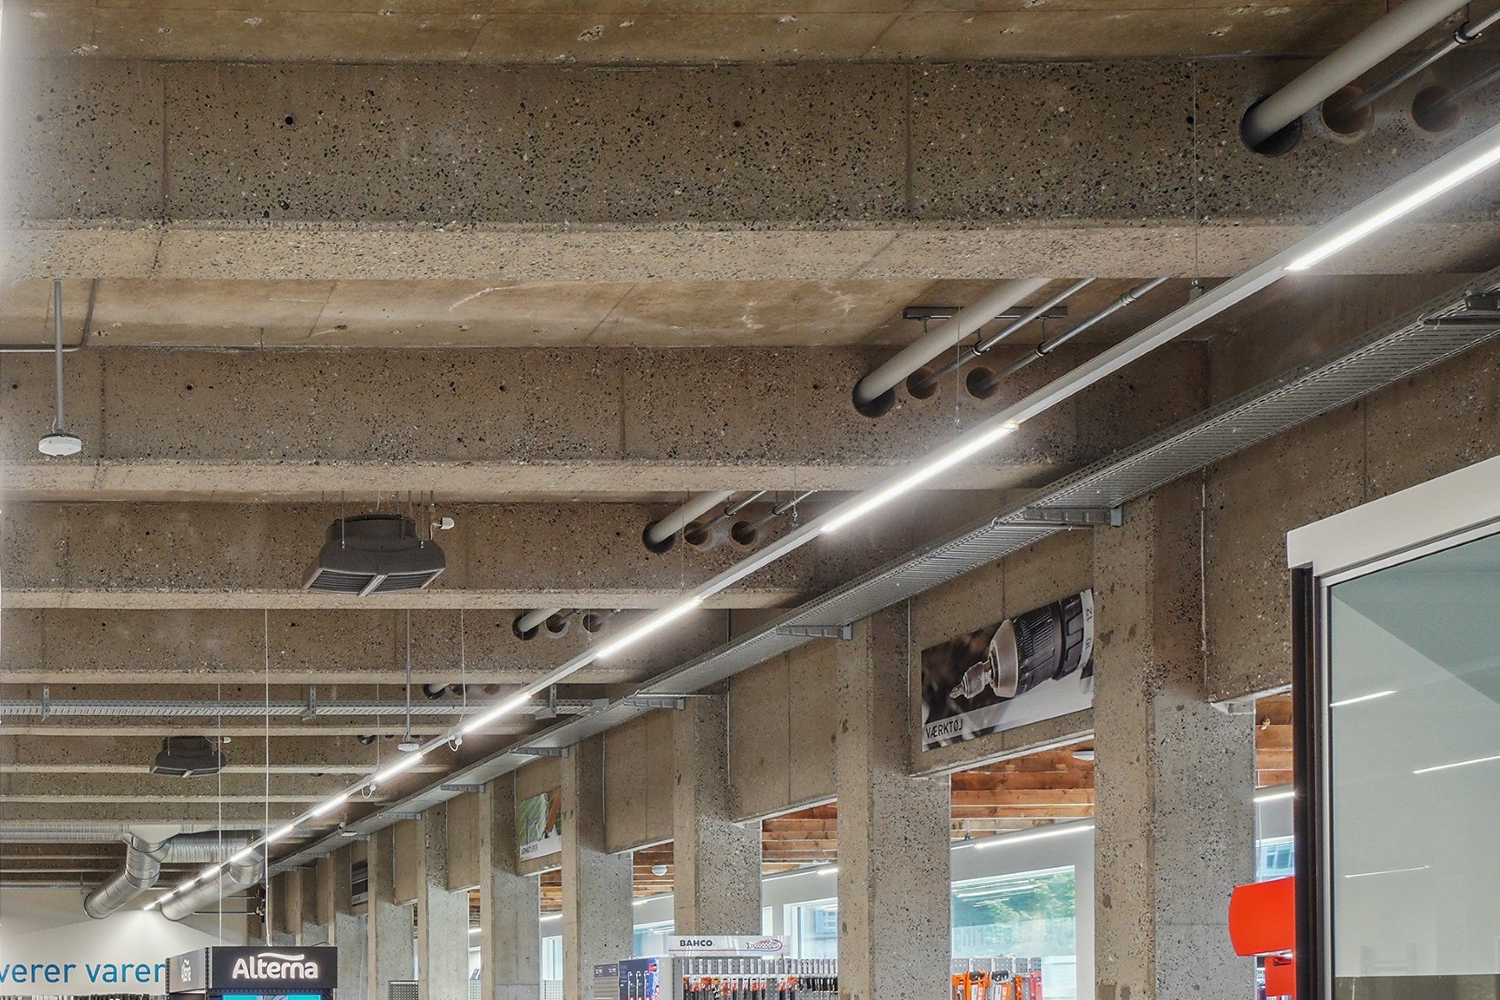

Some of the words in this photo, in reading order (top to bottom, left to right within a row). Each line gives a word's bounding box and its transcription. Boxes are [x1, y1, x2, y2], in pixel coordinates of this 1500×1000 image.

[925, 718, 964, 740] VÆRKTØJ
[680, 939, 713, 947] BAHCO
[232, 953, 319, 979] Alterna
